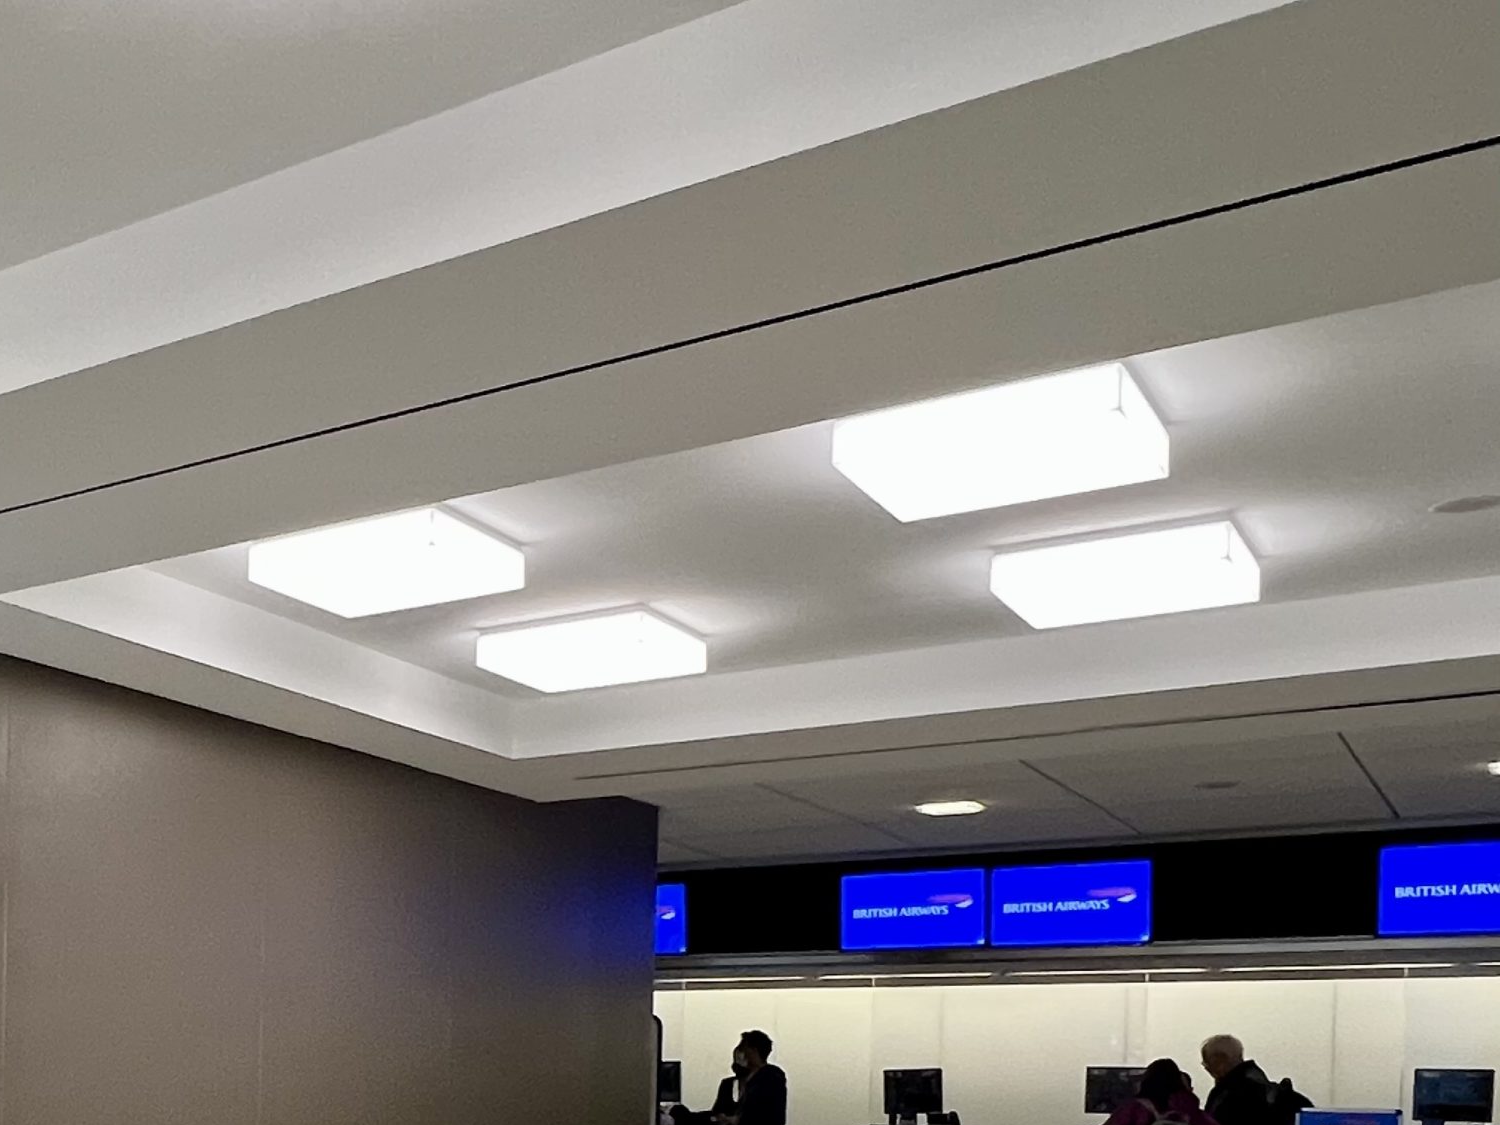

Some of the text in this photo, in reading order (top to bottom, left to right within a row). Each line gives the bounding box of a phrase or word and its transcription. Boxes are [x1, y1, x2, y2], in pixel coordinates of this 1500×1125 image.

[1394, 882, 1500, 898] BRITISH AIRW
[853, 905, 949, 919] BRITISH AIRWAYS
[1002, 899, 1109, 914] BRITISH AIRWAYS
